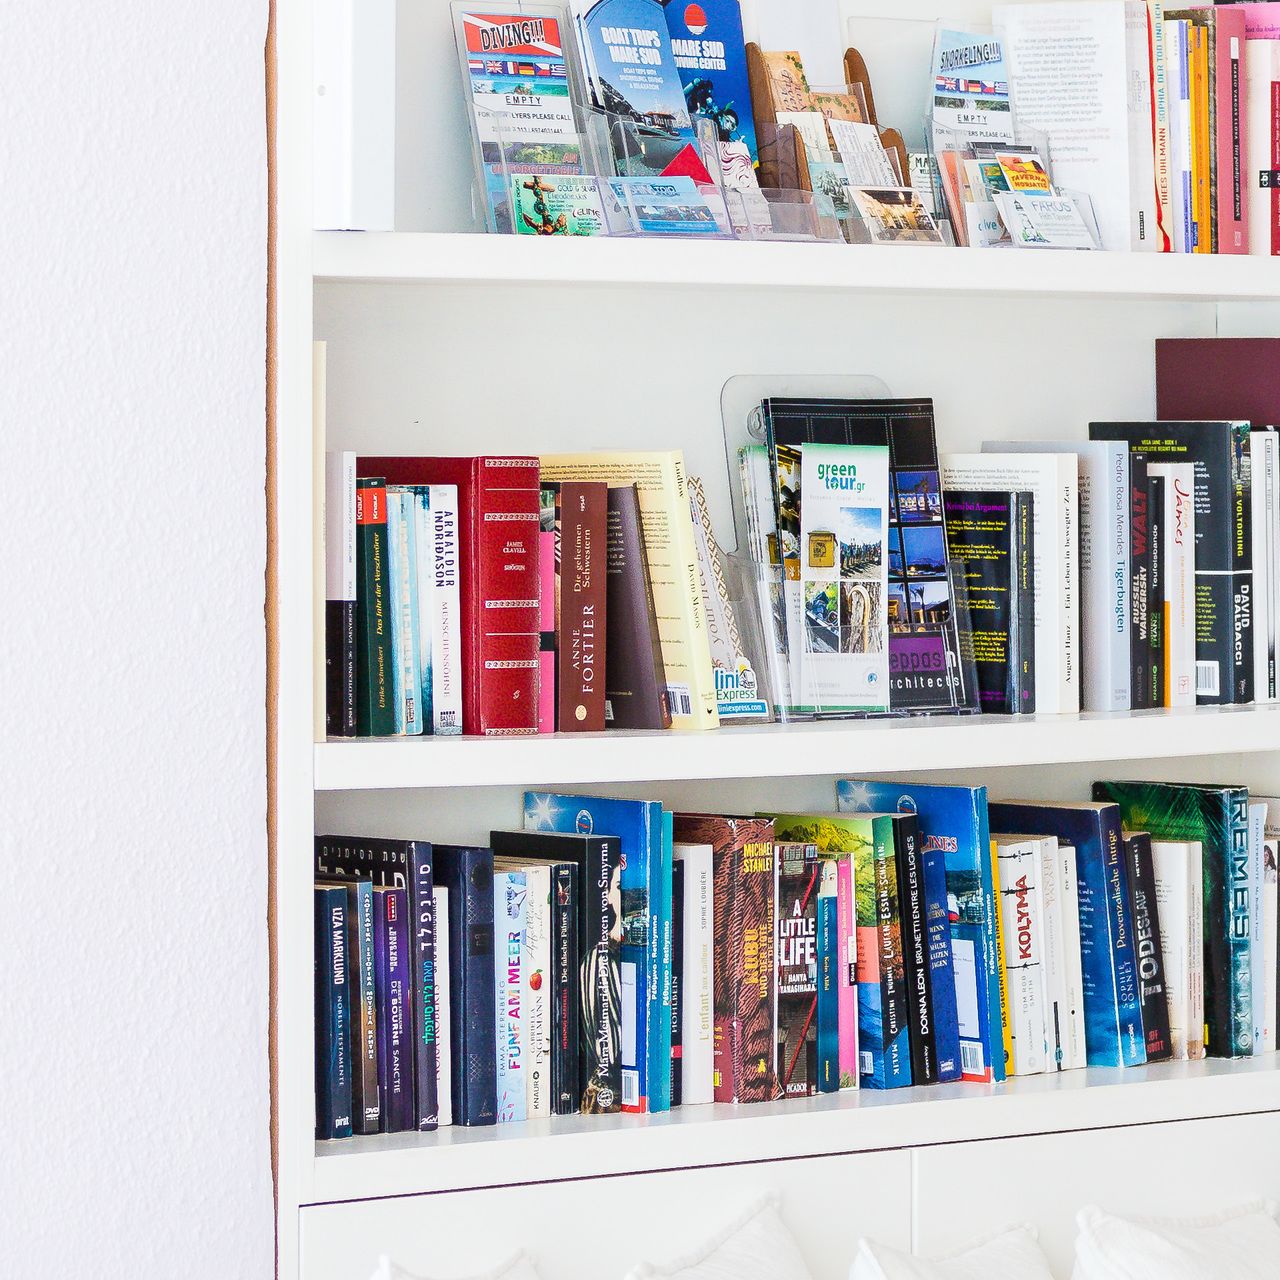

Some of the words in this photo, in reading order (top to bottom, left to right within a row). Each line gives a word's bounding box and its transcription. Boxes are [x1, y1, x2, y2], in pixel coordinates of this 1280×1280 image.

[481, 20, 544, 50] DIVING!!!
[600, 26, 631, 45] BOAT
[629, 28, 662, 48] TRIPS
[1155, 22, 1163, 40] UND
[608, 45, 641, 64] MARE
[639, 47, 662, 66] SUD
[671, 39, 702, 57] MARE
[702, 40, 725, 58] SUD
[940, 40, 1002, 70] SNORKELING!!!
[1156, 44, 1164, 65] TOD
[699, 57, 727, 71] CENTER
[1157, 65, 1165, 84] DER
[505, 95, 543, 105] EMPTY
[556, 113, 572, 121] CALL
[957, 114, 988, 123] EMPTY
[980, 130, 999, 138] PLEASE
[1158, 127, 1167, 171] UHLMANN
[562, 152, 578, 164] AN
[1160, 170, 1168, 206] THEES
[1031, 199, 1073, 213] FARUS
[674, 461, 685, 499] Ludlow
[817, 463, 857, 480] green
[1115, 453, 1124, 483] Pedro
[824, 476, 866, 493] tour.gr
[1115, 484, 1124, 512] Rosa
[1235, 483, 1243, 498] DE
[1133, 487, 1147, 557] WALT
[1174, 478, 1190, 546] James
[1115, 513, 1124, 556] Mendes
[1235, 498, 1243, 557] VOLTOOIING
[374, 532, 382, 583] Verschwörer
[445, 511, 455, 587] ARNALDUR
[574, 523, 583, 574] geheimen
[582, 528, 591, 588] Schwestern
[1065, 550, 1071, 560] in
[573, 575, 581, 594] Die
[1115, 559, 1125, 634] Tigerbugten
[1132, 573, 1140, 625] RUSSELL
[1139, 565, 1148, 641] WANGERSKY
[1240, 584, 1250, 629] DAVID
[1234, 594, 1243, 666] BALDACCI
[572, 629, 581, 671] ANNE
[582, 604, 594, 693] FORTIER
[714, 668, 739, 689] lini
[716, 690, 757, 702] Express
[323, 846, 374, 861] הסימנים
[383, 852, 406, 865] שפת
[743, 842, 773, 858] MICHAEL
[906, 835, 915, 869] LIGNES
[1108, 829, 1118, 867] Intrige
[598, 842, 610, 888] Smyrna
[743, 856, 774, 873] STANLEY
[909, 870, 917, 887] LES
[1232, 796, 1250, 939] REMES
[417, 863, 432, 952] סיינפלד
[599, 889, 609, 912] von
[793, 899, 802, 917] A
[911, 888, 919, 919] ENTRE
[1110, 869, 1127, 949] Provenzalische
[332, 907, 343, 928] LIZA
[780, 918, 816, 937] LITTLE
[1016, 874, 1033, 960] KOLYMA
[758, 923, 768, 948] TOTE
[914, 918, 923, 965] BRUNETTI
[332, 930, 345, 985] MARKLUND
[507, 931, 521, 983] MEER
[743, 928, 760, 985] KUBU
[758, 948, 768, 973] DER
[779, 937, 816, 967] LIFE
[424, 960, 434, 983] מאת
[767, 962, 774, 973] IN
[788, 973, 808, 984] HANYA
[917, 968, 926, 994] LEON
[391, 981, 399, 995] DE
[758, 973, 768, 999] UND
[1117, 962, 1129, 1010] SOPHIE
[1127, 960, 1136, 1010] BONNET
[366, 990, 374, 1026] ΜΟΥΣΕΙΑ
[507, 989, 521, 1020] AM
[920, 996, 928, 1035] DONNA
[391, 998, 400, 1047] BOURNE
[424, 1006, 434, 1046] סיינפלד
[507, 1022, 521, 1071] FÜNF
[598, 1046, 609, 1077] Mara
[892, 1043, 900, 1075] MALIK
[392, 1048, 401, 1094] SANCTIE
[786, 1083, 808, 1094] PICADOR
